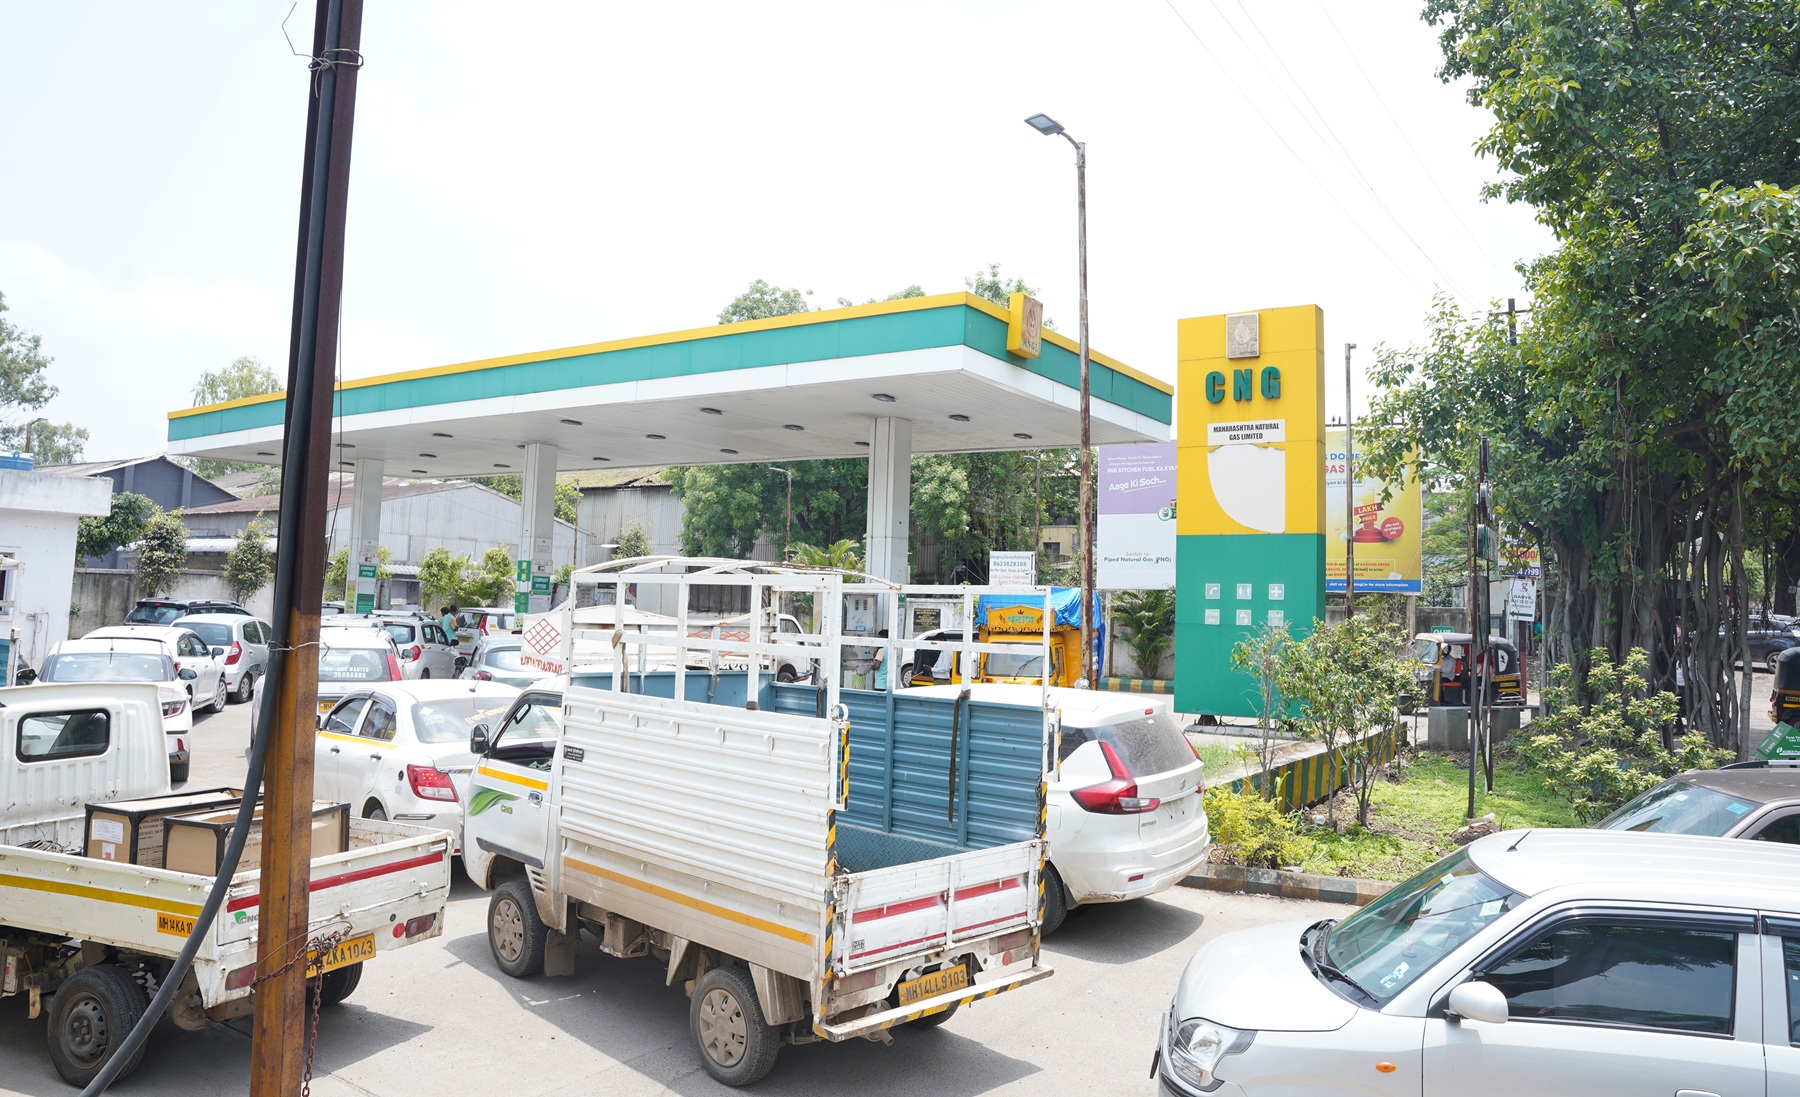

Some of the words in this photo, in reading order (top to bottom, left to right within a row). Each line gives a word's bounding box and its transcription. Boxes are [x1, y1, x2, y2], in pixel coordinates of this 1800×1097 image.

[1205, 366, 1281, 403] CNG
[1213, 424, 1254, 433] MAHARASHTRA
[1255, 422, 1279, 431] NATURAL
[1229, 433, 1240, 441] GAS
[1241, 432, 1263, 440] LIMITED
[1109, 483, 1129, 491] Aage
[1130, 479, 1139, 488] Ki
[1358, 504, 1378, 514] LAKH
[159, 916, 168, 930] MH
[169, 918, 174, 932] 14
[175, 919, 185, 933] KA
[239, 914, 259, 924] CNG
[905, 969, 966, 1002] MH14LL9103
